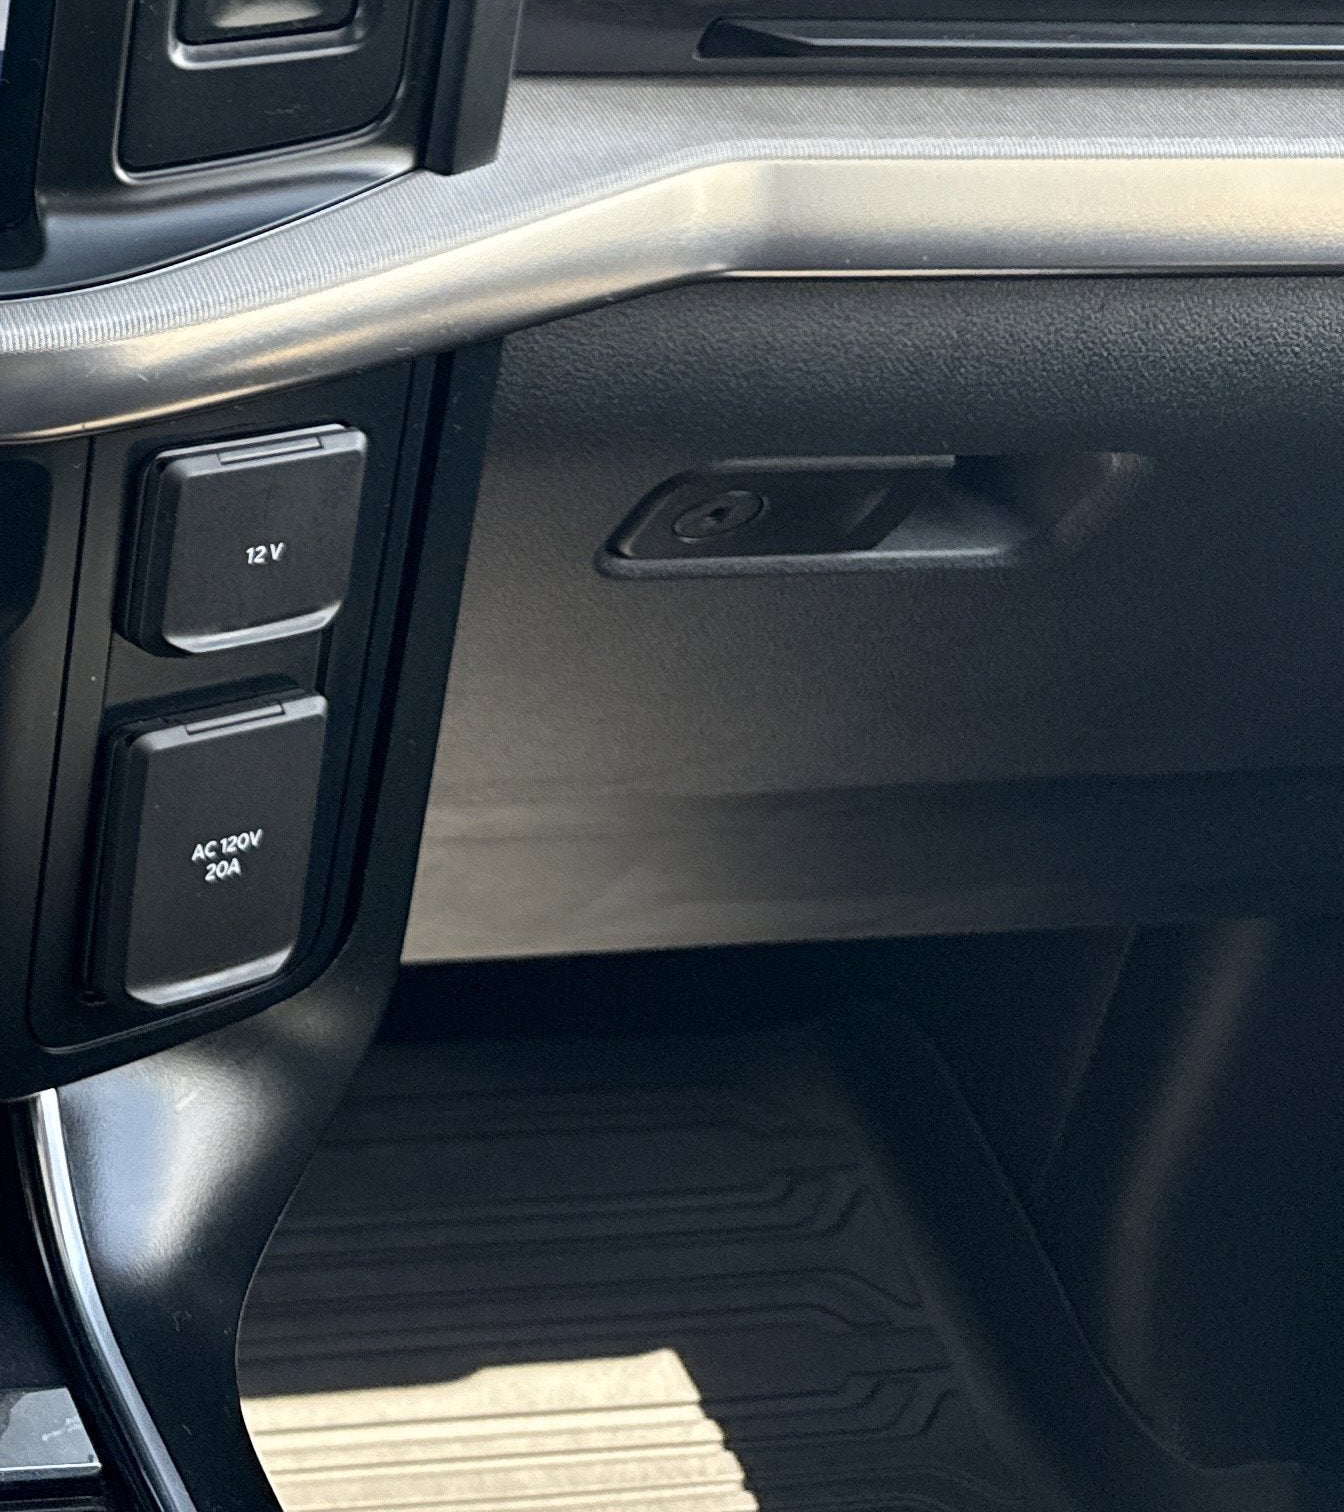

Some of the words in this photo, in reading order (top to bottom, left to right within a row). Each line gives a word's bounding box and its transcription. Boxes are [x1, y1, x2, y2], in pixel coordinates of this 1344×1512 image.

[191, 839, 217, 863] AC
[220, 829, 263, 855] 120V
[205, 858, 241, 881] 20A
